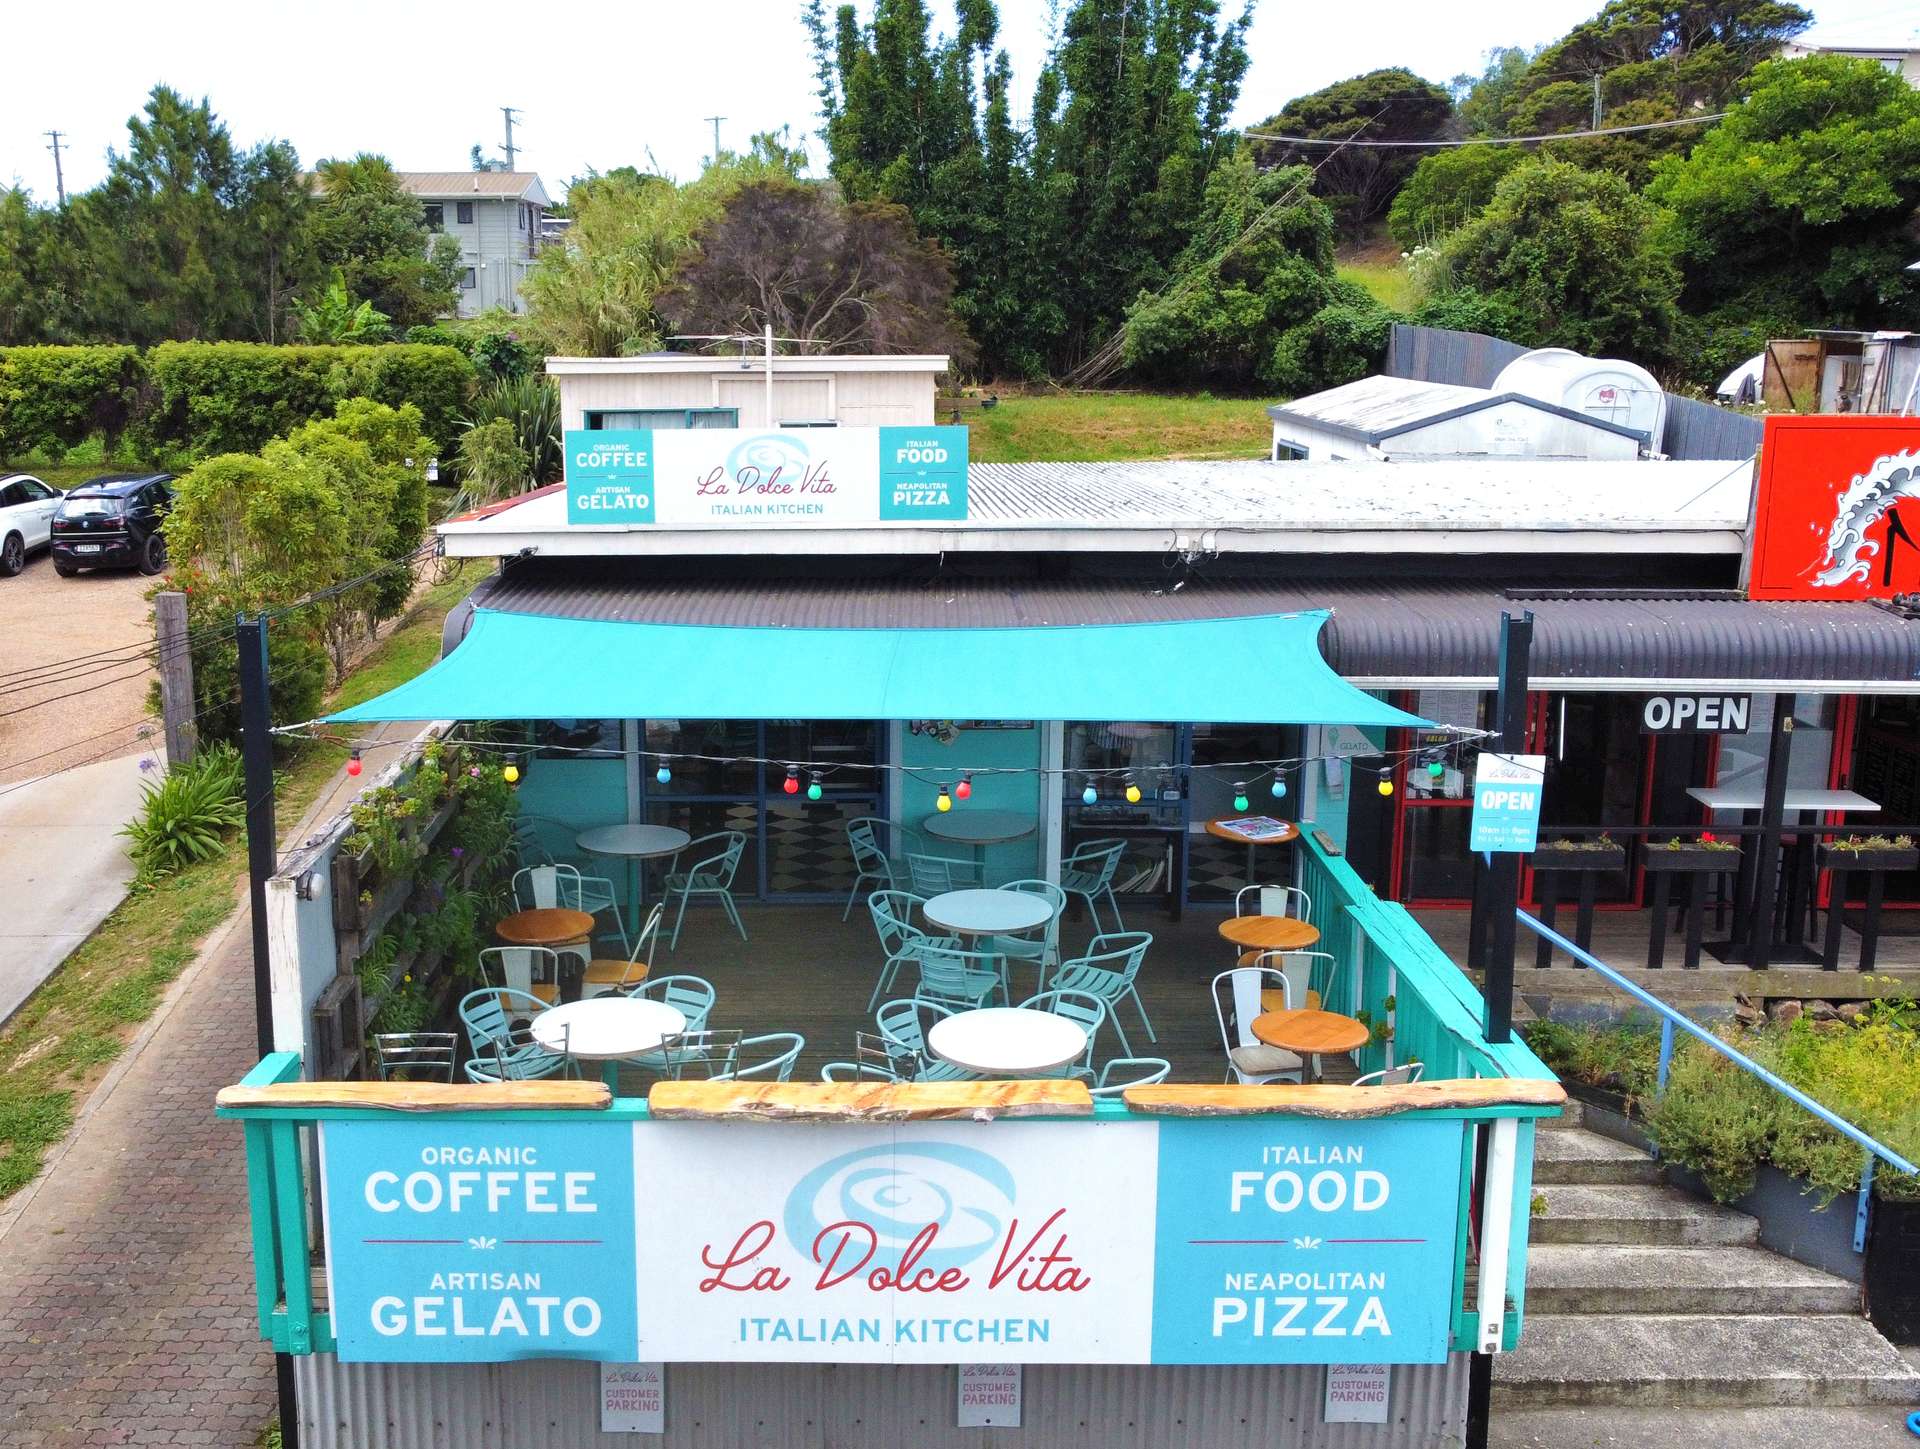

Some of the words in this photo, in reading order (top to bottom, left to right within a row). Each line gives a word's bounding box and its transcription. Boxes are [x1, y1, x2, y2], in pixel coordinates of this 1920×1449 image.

[592, 444, 630, 452] ORGANIC
[906, 440, 939, 448] ITALIAN
[576, 452, 648, 467] COFFEE
[896, 448, 948, 464] FOOD
[697, 466, 730, 495] La
[736, 466, 794, 494] Dolce
[800, 459, 837, 493] Vita
[595, 486, 631, 494] ARTISAN
[896, 482, 948, 490] NEAPOLITAN
[577, 494, 650, 510] GELATO
[893, 490, 951, 506] PIZZA
[711, 505, 763, 515] ITALIAN
[767, 503, 824, 514] KITCHEN
[1644, 696, 1750, 730] OPEN
[1481, 790, 1535, 810] OPEN
[421, 1147, 538, 1165] ORGANIC
[1262, 1146, 1364, 1164] ITALIAN
[364, 1171, 598, 1213] COFFEE
[1230, 1170, 1391, 1213] FOOD
[699, 1220, 791, 1293] La
[812, 1220, 971, 1293] Dolce
[987, 1207, 1092, 1293] Vita
[429, 1272, 541, 1291] ARTISAN
[1225, 1272, 1386, 1291] NEAPOLITAN
[370, 1296, 601, 1337] GELATO
[1212, 1296, 1392, 1337] PIZZA
[739, 1318, 880, 1343] ITALIAN
[894, 1318, 1050, 1343] KITCHEN
[963, 1383, 1017, 1393] CUSTOMER
[1331, 1380, 1385, 1390] CUSTOMER
[606, 1389, 659, 1399] CUSTOMER
[963, 1393, 1017, 1406] PARKING
[1330, 1390, 1385, 1402] PARKING
[606, 1399, 660, 1411] PARKING
